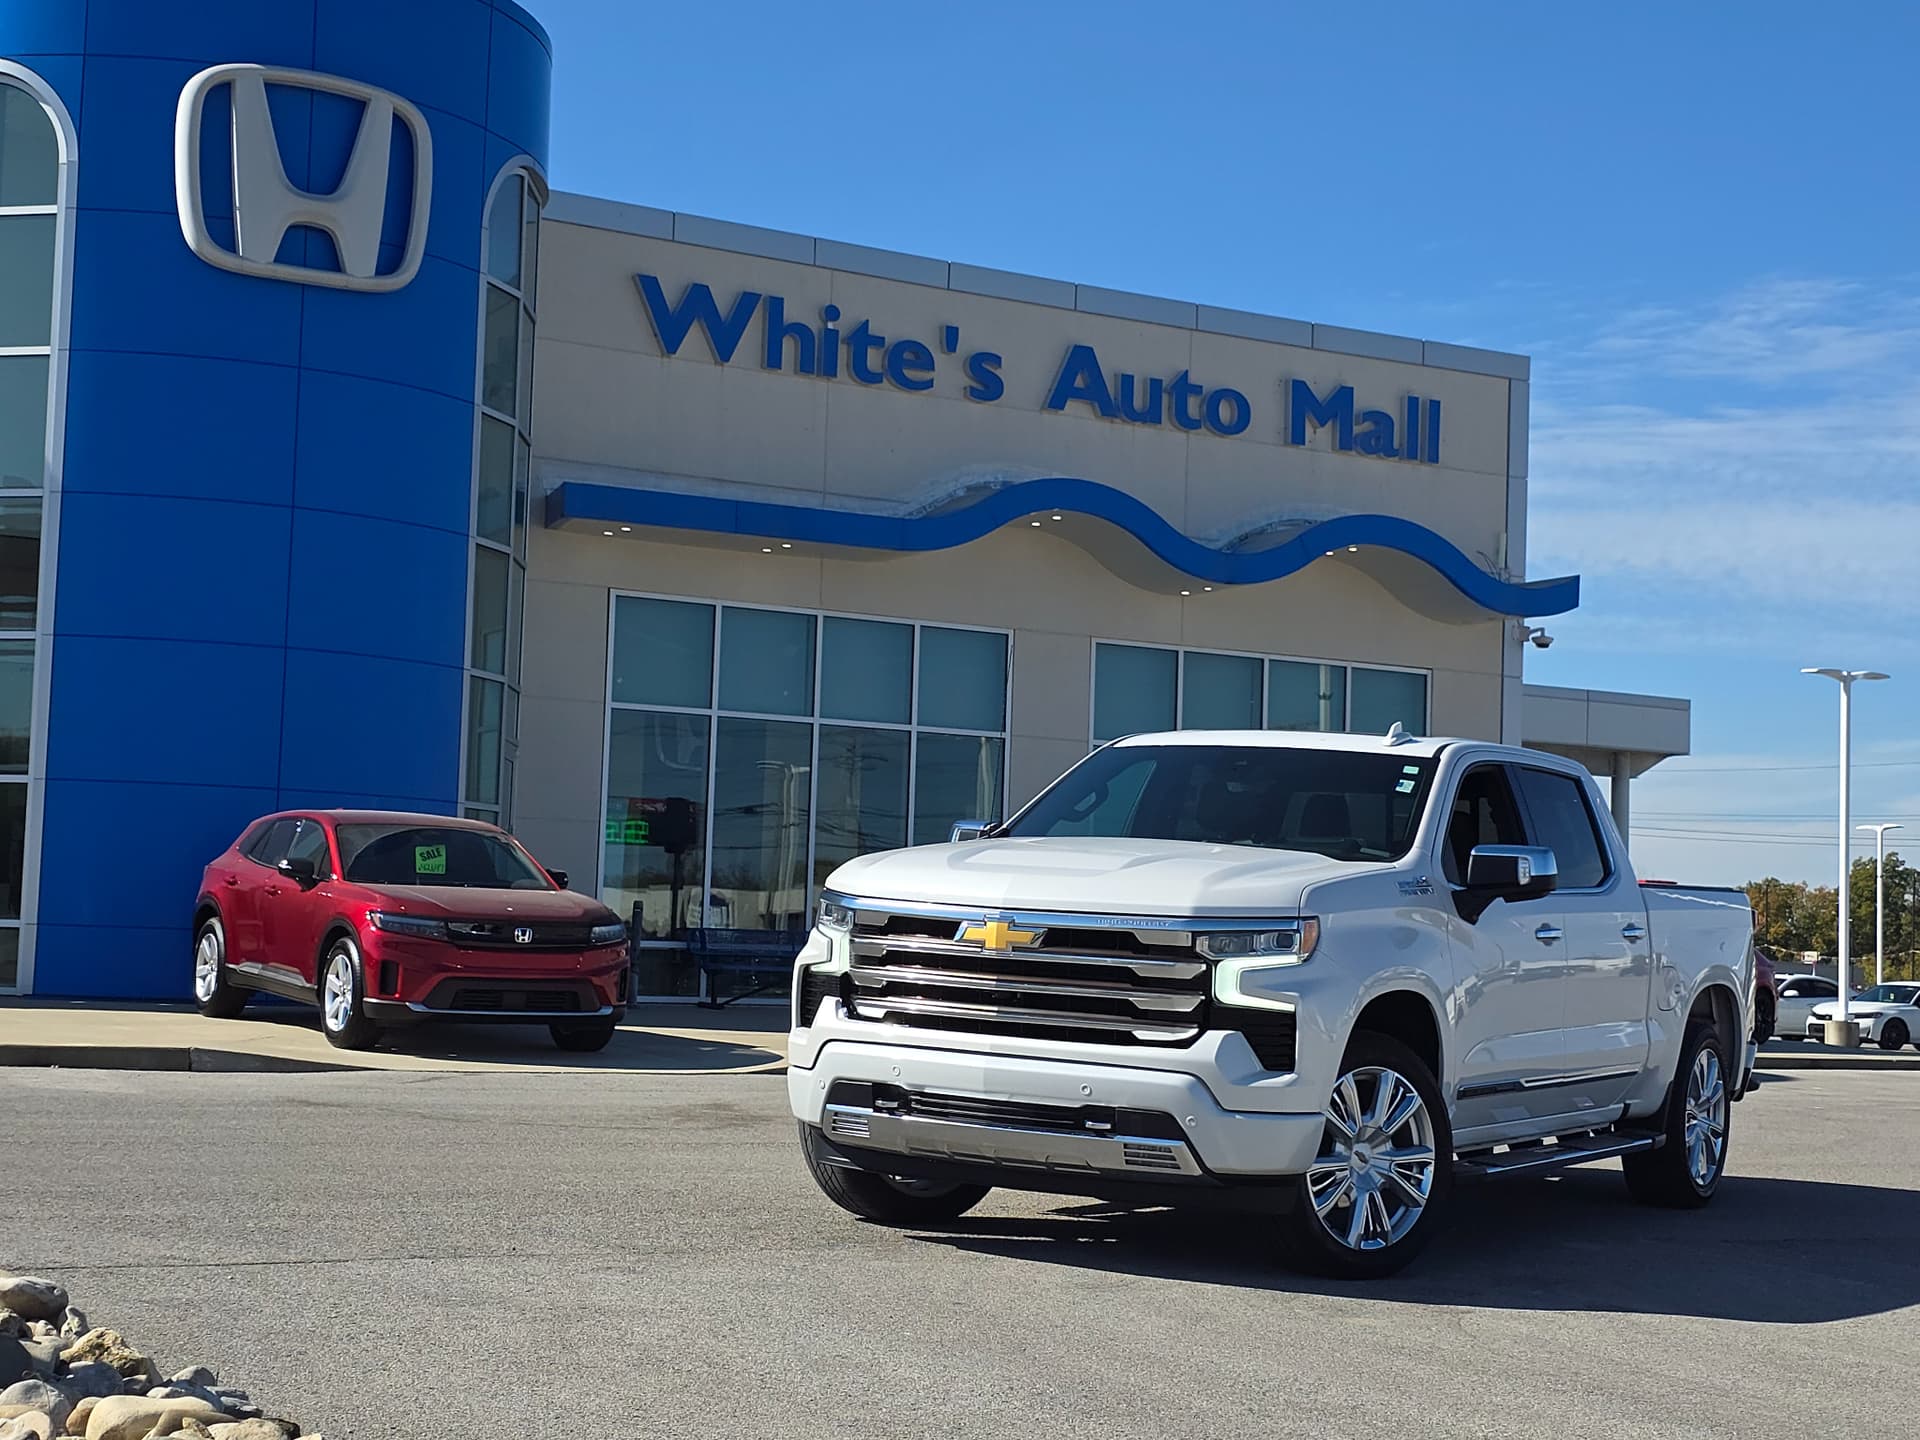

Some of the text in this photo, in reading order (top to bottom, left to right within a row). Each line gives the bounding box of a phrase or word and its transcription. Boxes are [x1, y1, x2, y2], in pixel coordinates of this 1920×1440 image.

[634, 273, 1442, 464] White's Auto Mall
[419, 847, 443, 862] SALE
